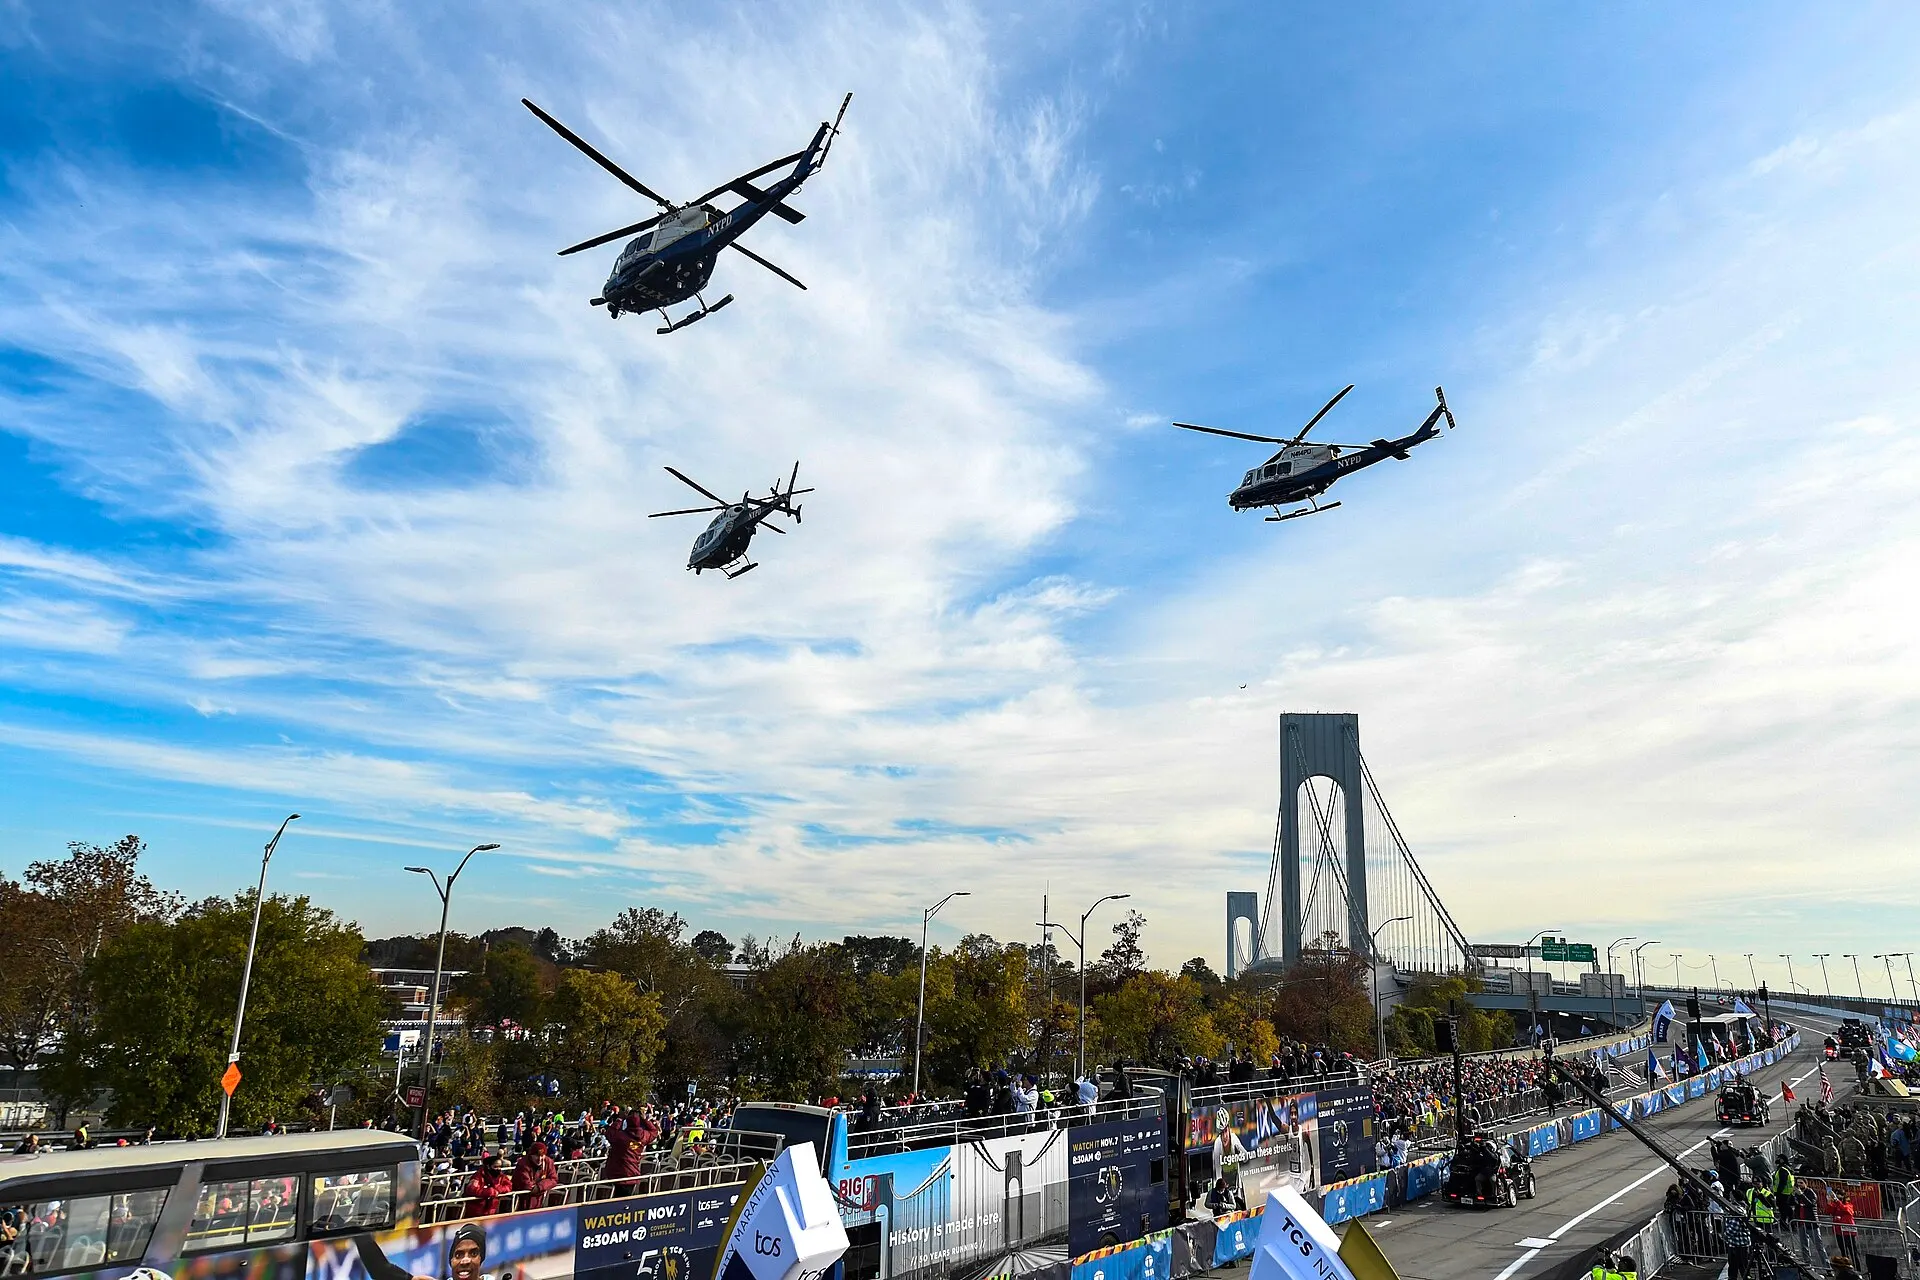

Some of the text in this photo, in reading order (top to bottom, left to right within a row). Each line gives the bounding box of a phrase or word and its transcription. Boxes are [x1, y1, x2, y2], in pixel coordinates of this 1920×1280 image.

[708, 214, 732, 238] NYPD
[1337, 454, 1361, 468] NYPD
[1333, 1120, 1348, 1146] 50
[1072, 1137, 1118, 1152] WATCH IT NOV. 7
[1220, 1142, 1293, 1166] Legends run these streets.
[1072, 1152, 1093, 1165] 8:30AM
[839, 1177, 861, 1198] BIG
[1096, 1166, 1122, 1203] 50
[584, 1204, 687, 1230] WATCH IT NOV. 7
[698, 1200, 710, 1212] tcs
[650, 1223, 676, 1231] COVERAGE
[720, 1163, 780, 1277] CITY MARATHON
[889, 1212, 1002, 1247] History is made here.
[582, 1230, 629, 1248] 8:30AM
[755, 1229, 782, 1257] tcs
[1281, 1216, 1313, 1256] TCS
[682, 1253, 690, 1268] NEW
[930, 1249, 950, 1260] YEARS
[952, 1242, 978, 1254] RUNNING
